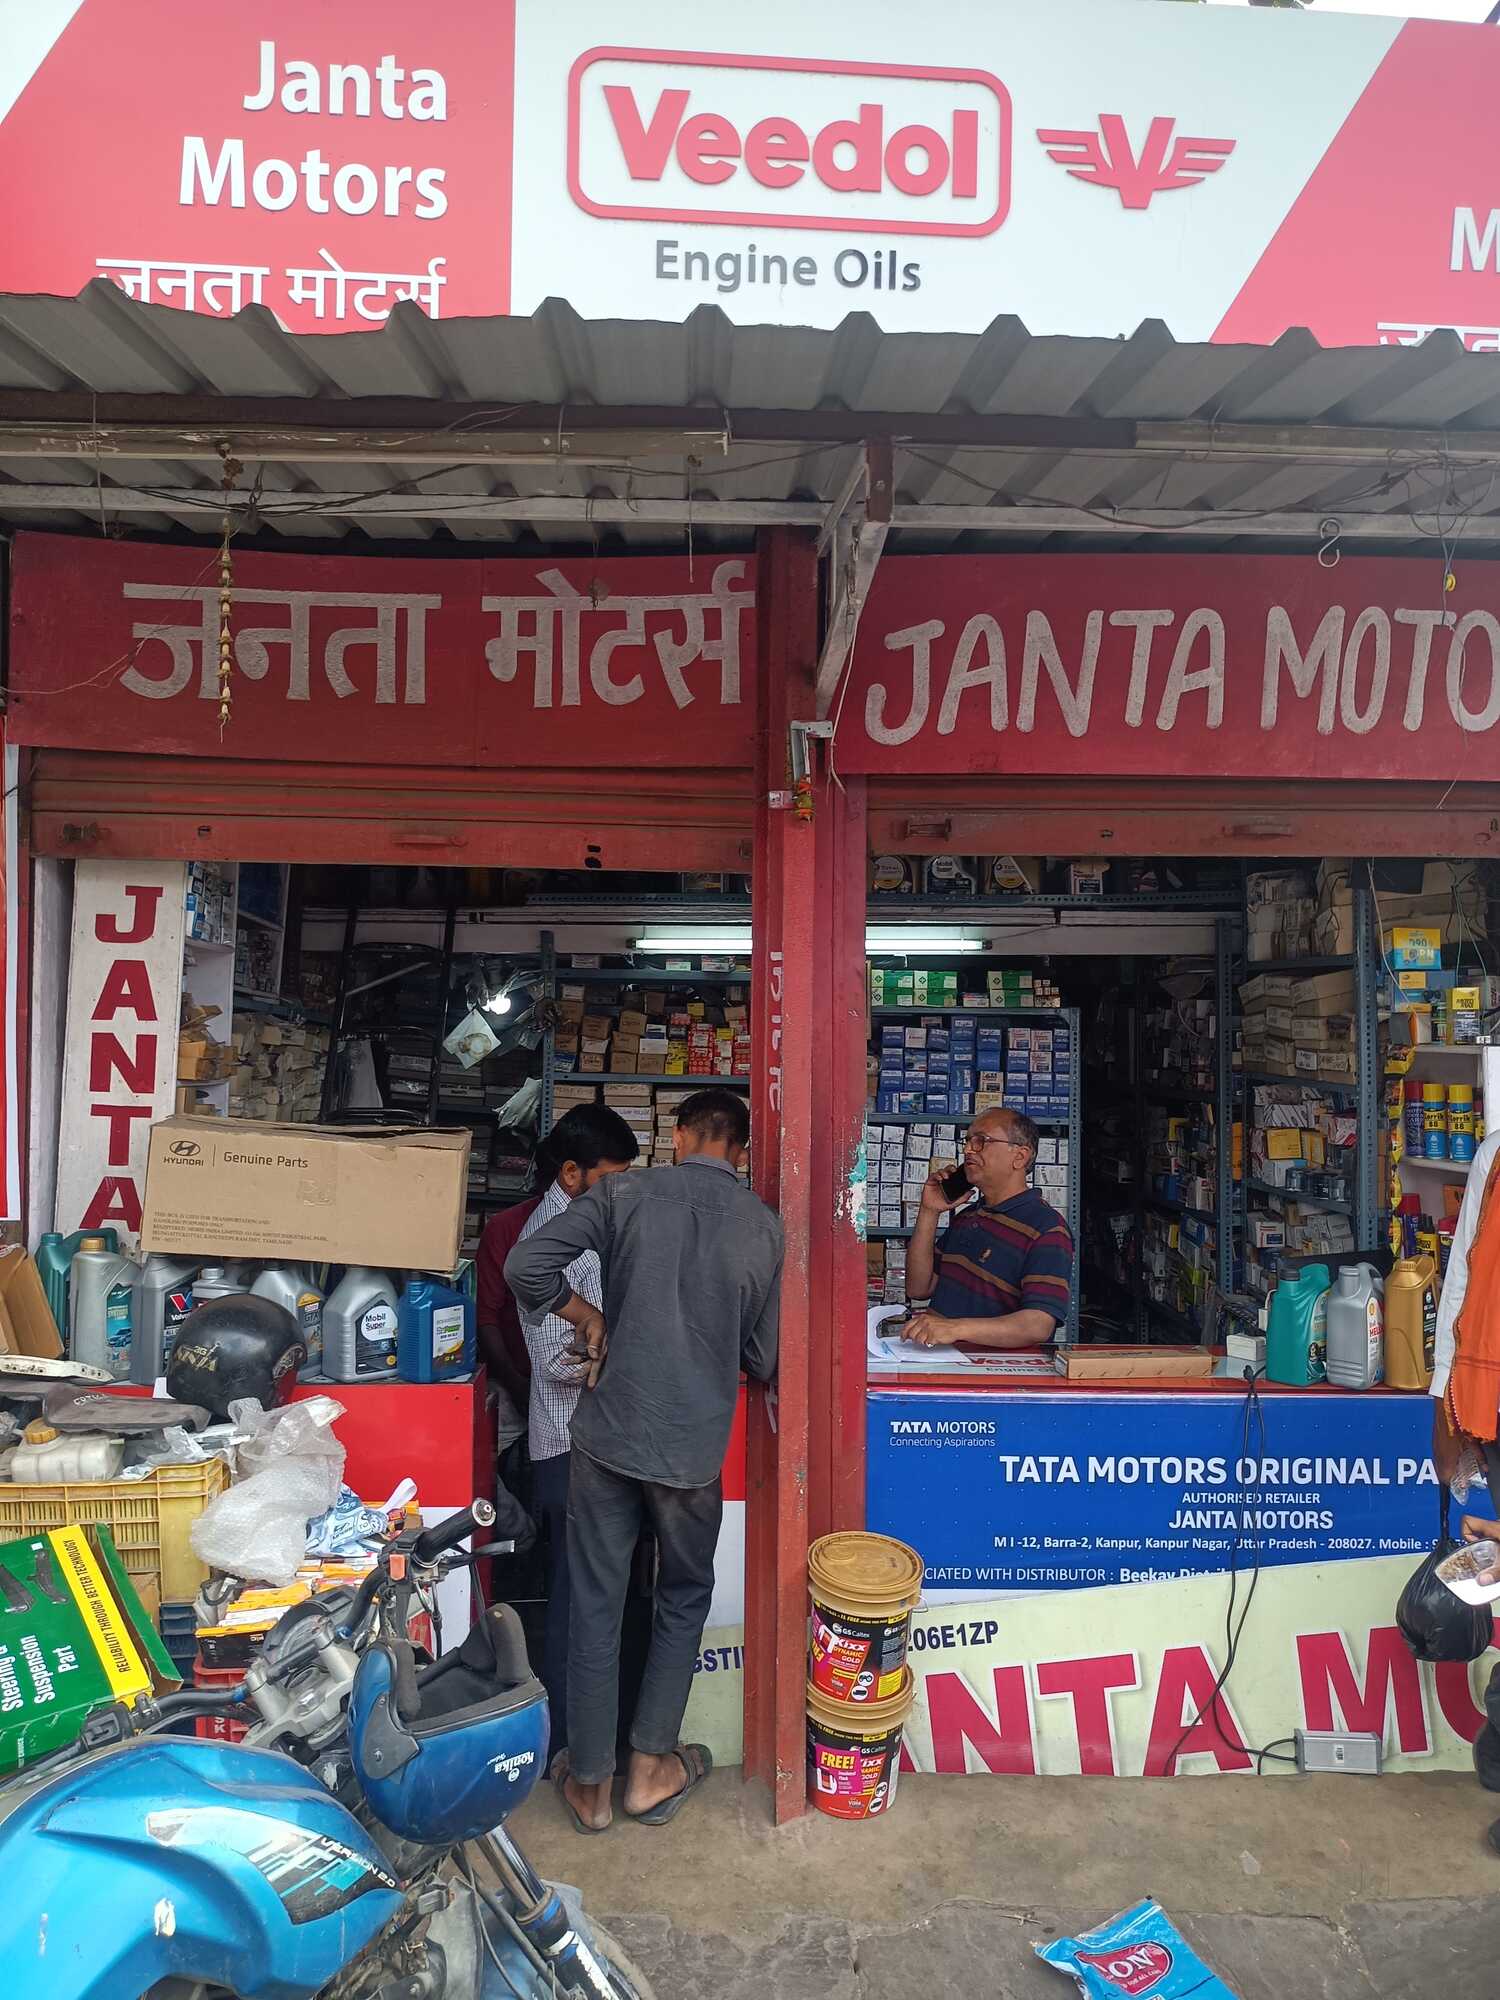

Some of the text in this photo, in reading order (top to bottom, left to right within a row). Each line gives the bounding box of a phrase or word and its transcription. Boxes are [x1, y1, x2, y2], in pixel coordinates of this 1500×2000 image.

[243, 40, 448, 123] Janta
[603, 84, 979, 199] Veedol
[178, 135, 449, 220] Motors
[655, 239, 922, 292] Engine Oils
[119, 559, 756, 709] जनता मोटर्स
[865, 604, 1500, 746] JANTA MOTO
[79, 884, 164, 1232] JANTA
[163, 1157, 204, 1166] HYUNDAI
[223, 1151, 309, 1168] Genuine Parts
[365, 1312, 387, 1323] Mobil
[365, 1321, 386, 1331] Super
[889, 1437, 996, 1448] Connecting Aspirations
[890, 1421, 996, 1434] TATA MOTORS
[999, 1455, 1081, 1484] TATA
[1087, 1455, 1227, 1485] MOTORS
[1235, 1457, 1390, 1485] ORIGINAL
[1265, 1493, 1321, 1504] RETAILER
[1168, 1510, 1334, 1530] JANTA MOTORS
[1044, 1537, 1092, 1550] Barra-2,
[1095, 1537, 1142, 1551] Kanpur,
[1145, 1538, 1191, 1551] Kanpur
[1192, 1538, 1231, 1551] Nagar,
[1268, 1538, 1317, 1550] Pradesh
[1328, 1538, 1375, 1550] 208027.
[1379, 1538, 1422, 1550] Mobile
[975, 1567, 1012, 1581] WITH
[1016, 1567, 1106, 1581] DISTRIBUTOR
[62, 1538, 132, 1673] RELIABILITY THROUGH BETTER TECHNOLOGY
[837, 1637, 866, 1652] Kixx
[906, 1620, 998, 1652] 06E1ZP
[19, 1634, 56, 1704] Suspension
[52, 1644, 79, 1674] Part
[841, 1655, 861, 1664] GOLD
[0, 1655, 24, 1712] Steering
[900, 1645, 1254, 1777] NTA
[820, 1752, 855, 1770] FREE!
[320, 1837, 379, 1875] VERSION
